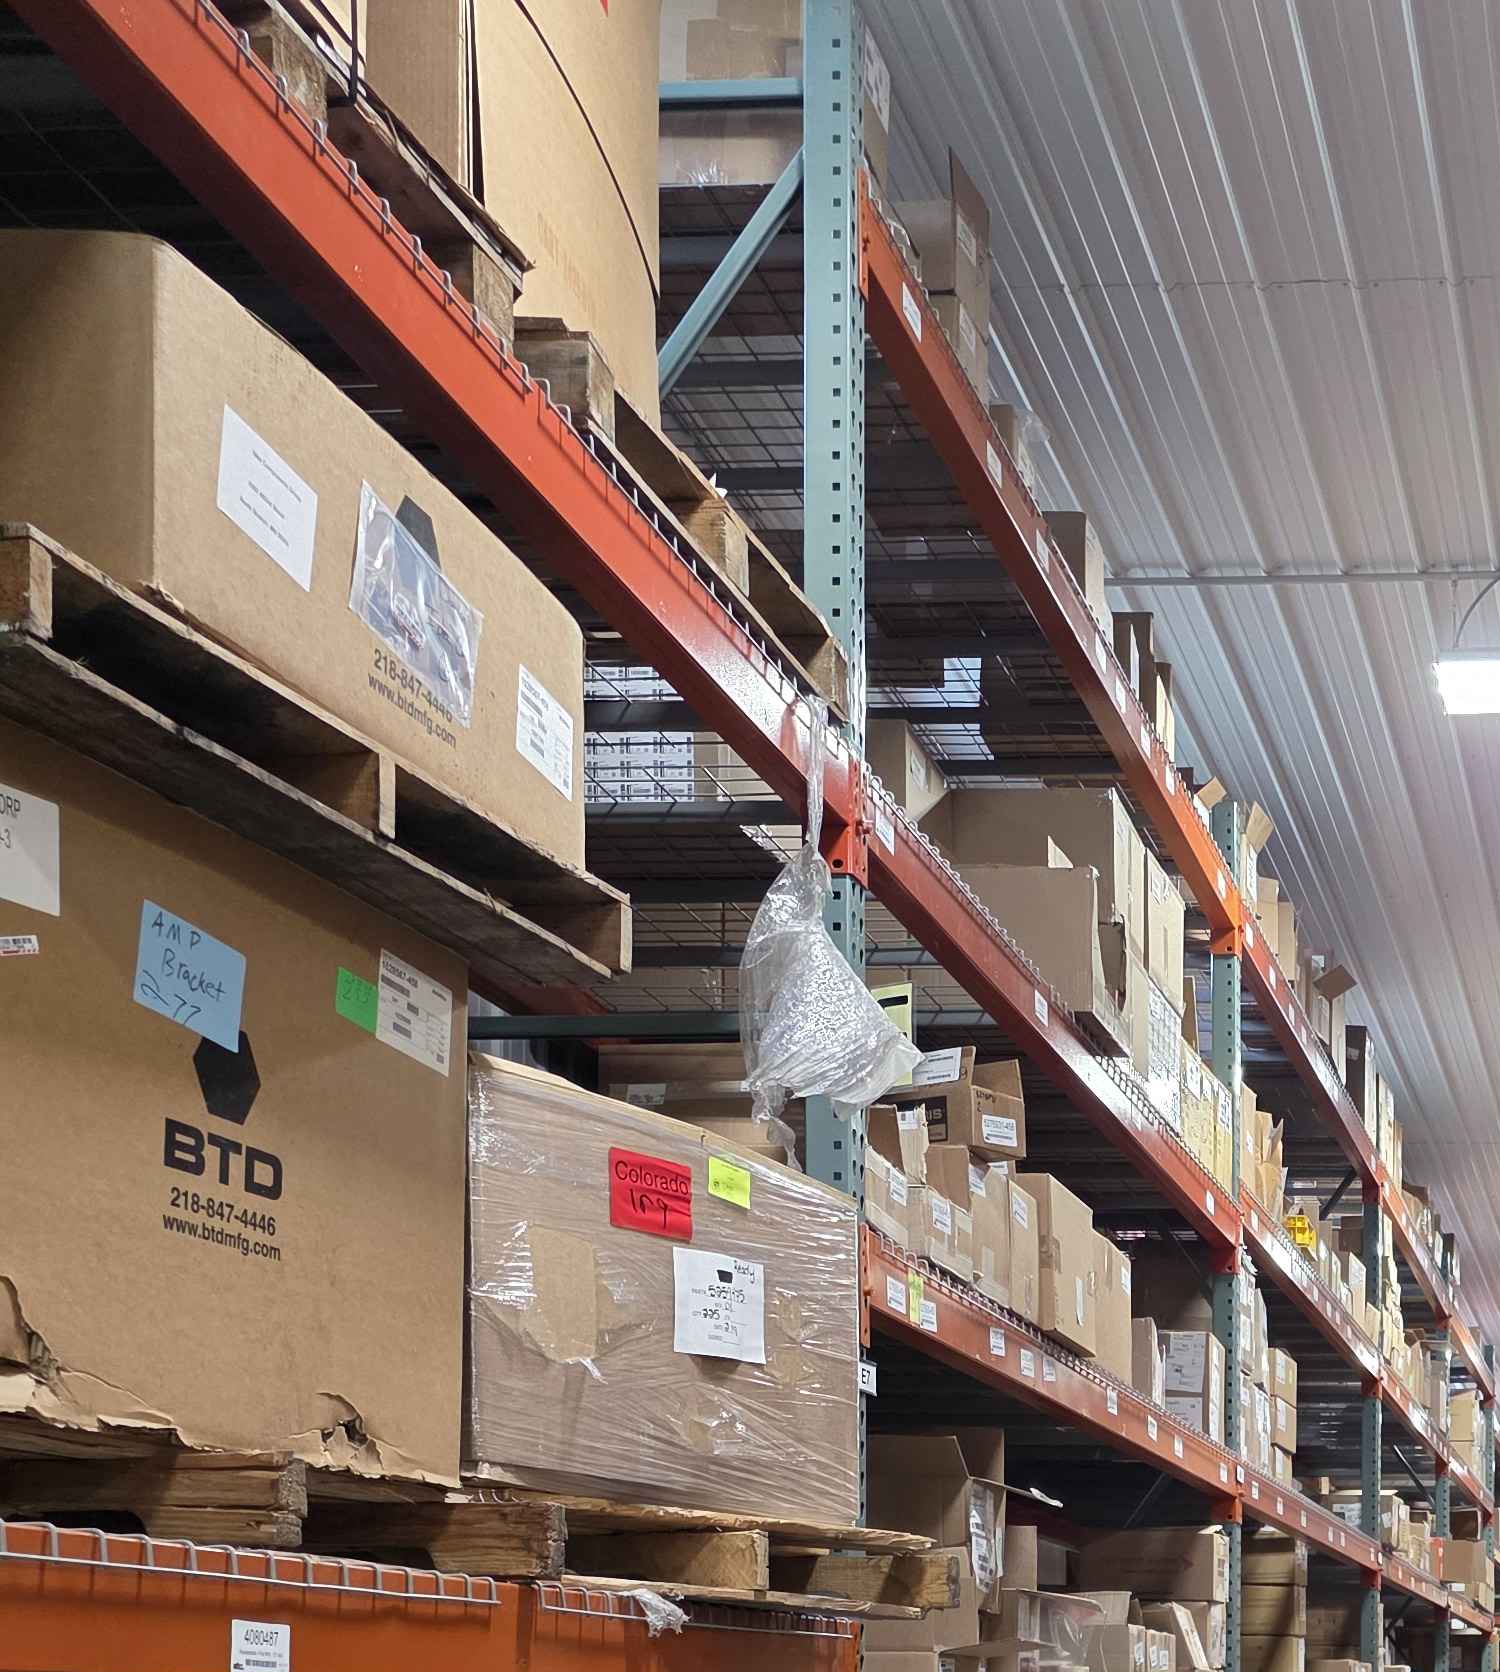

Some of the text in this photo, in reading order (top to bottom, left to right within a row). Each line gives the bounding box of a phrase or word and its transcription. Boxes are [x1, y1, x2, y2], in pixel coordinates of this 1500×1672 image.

[368, 673, 457, 749] www.btdmfg.com
[161, 947, 226, 1002] Bracket
[164, 1117, 283, 1201] BTD
[615, 1160, 690, 1196] Colorado
[162, 1213, 281, 1261] www.btdmfg.com
[170, 1186, 277, 1237] 218-847-4446
[861, 1367, 871, 1384] E7
